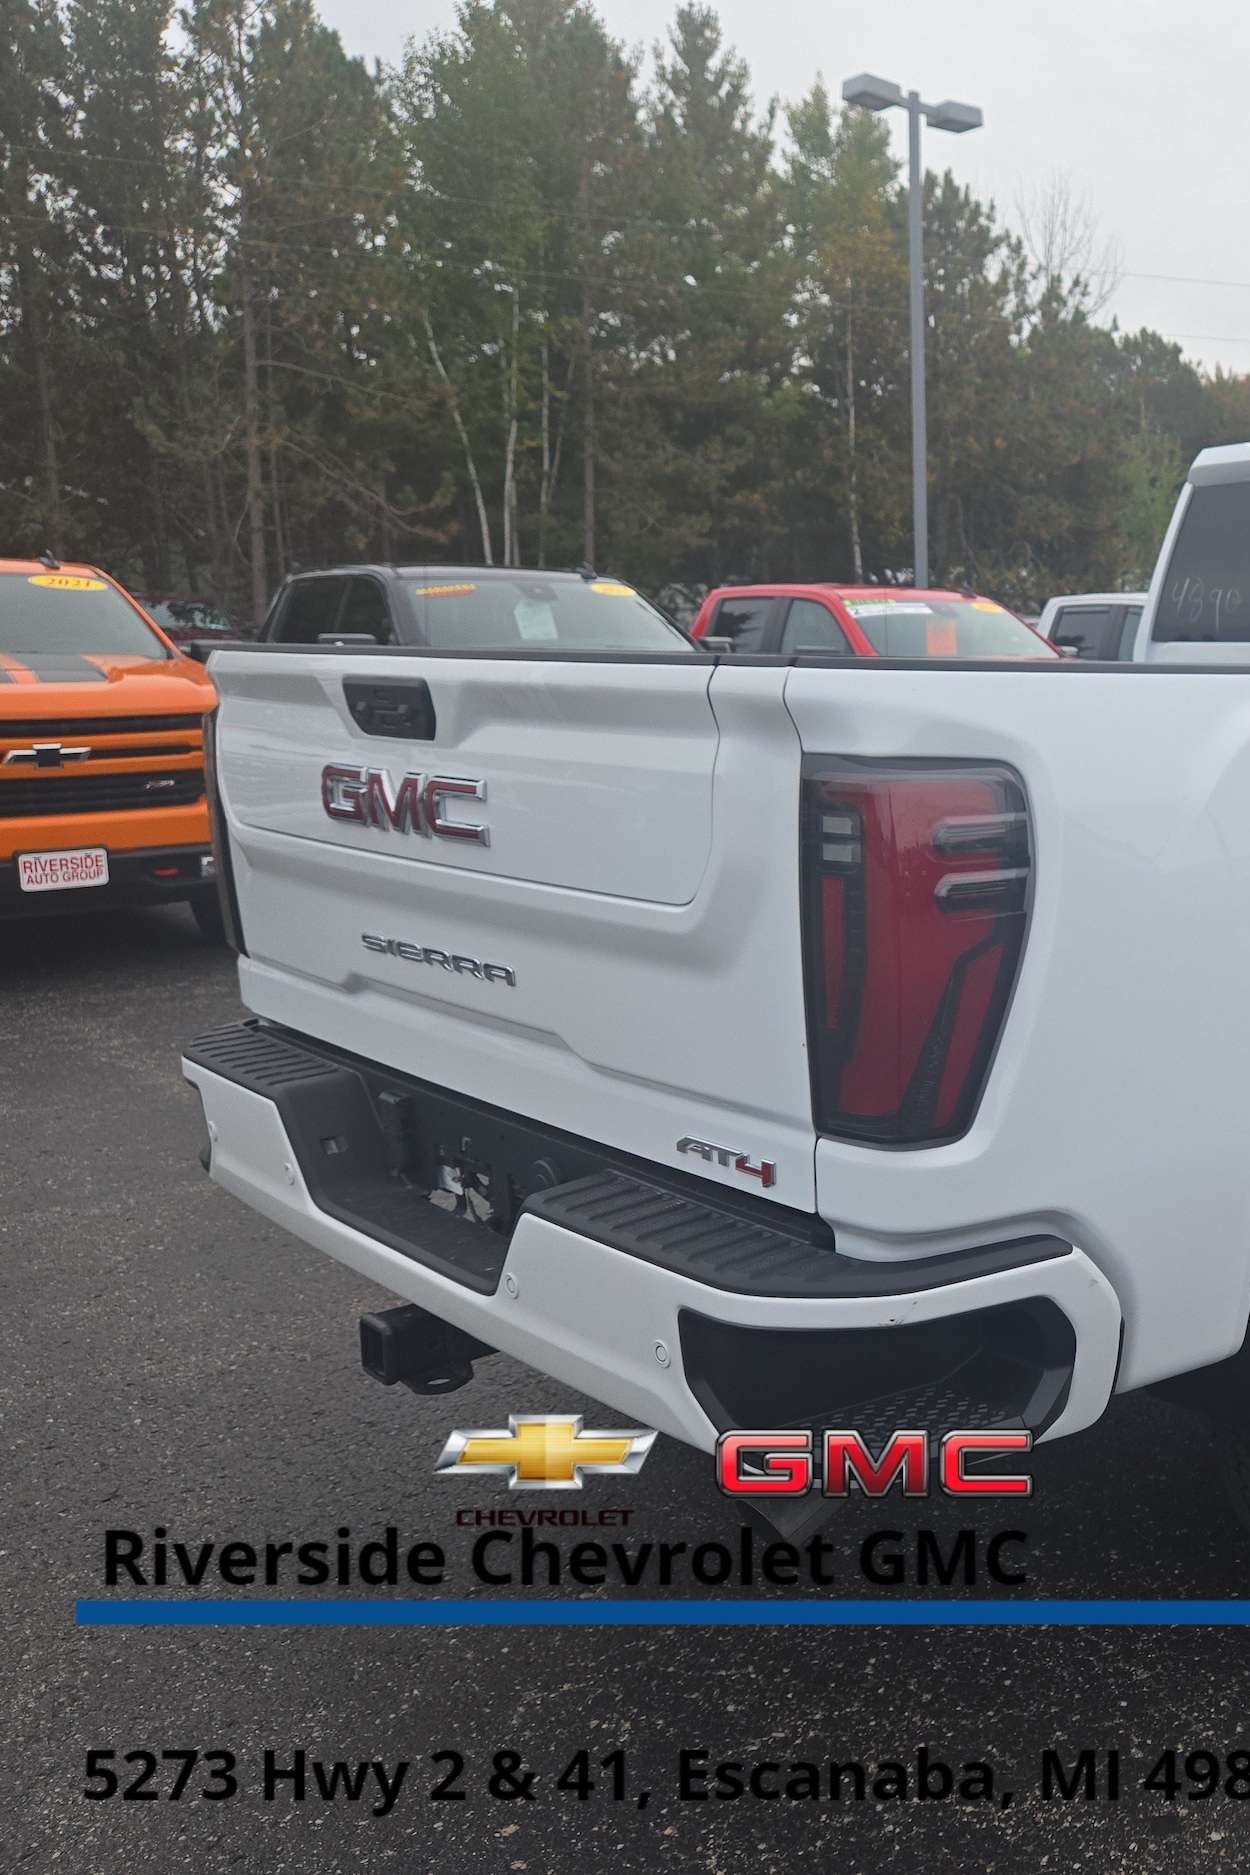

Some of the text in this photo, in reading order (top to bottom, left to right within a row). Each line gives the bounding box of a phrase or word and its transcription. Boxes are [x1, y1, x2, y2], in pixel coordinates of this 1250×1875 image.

[321, 762, 490, 847] GMC
[23, 854, 104, 874] RIVERSIDE
[27, 867, 103, 885] AUTO GROUP
[361, 932, 516, 987] SIERRA
[676, 1134, 777, 1188] AT4
